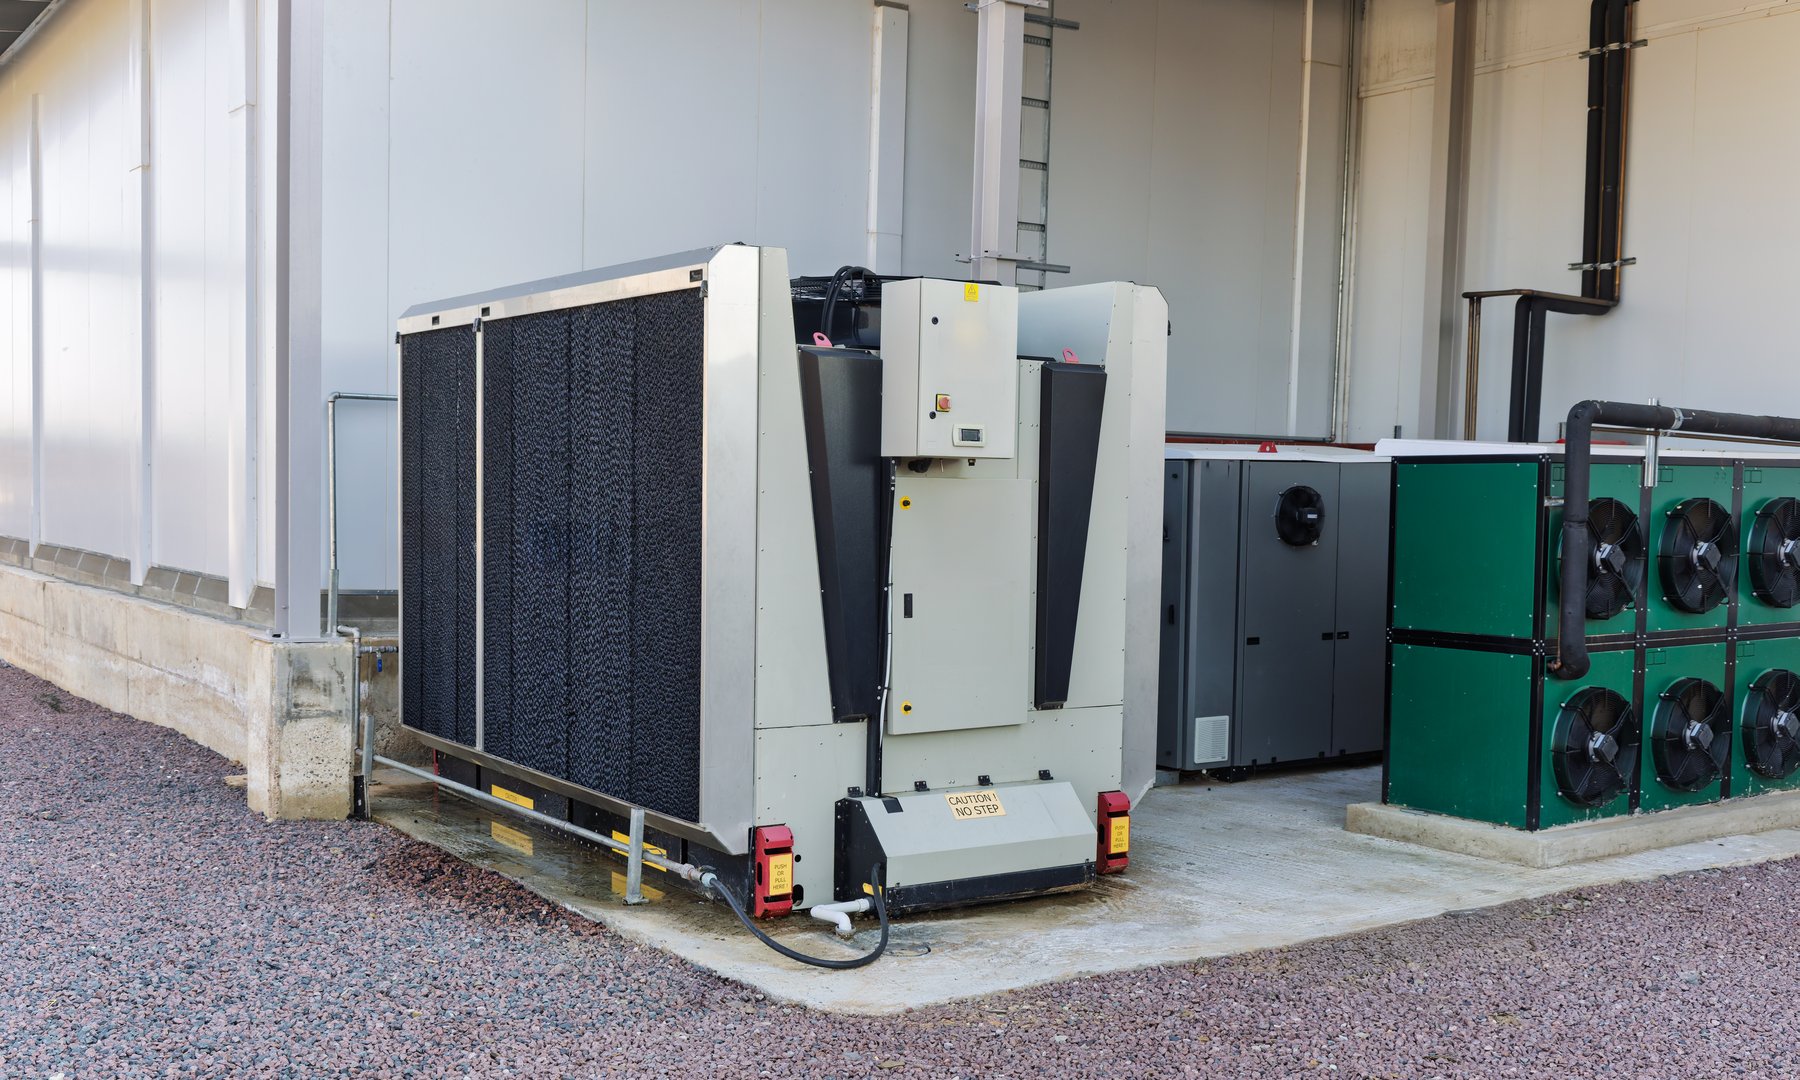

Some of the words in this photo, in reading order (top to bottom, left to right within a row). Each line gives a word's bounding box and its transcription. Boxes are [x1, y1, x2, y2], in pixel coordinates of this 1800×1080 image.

[948, 793, 992, 806] CAUTION
[955, 806, 972, 817] NO
[973, 804, 999, 815] STEP
